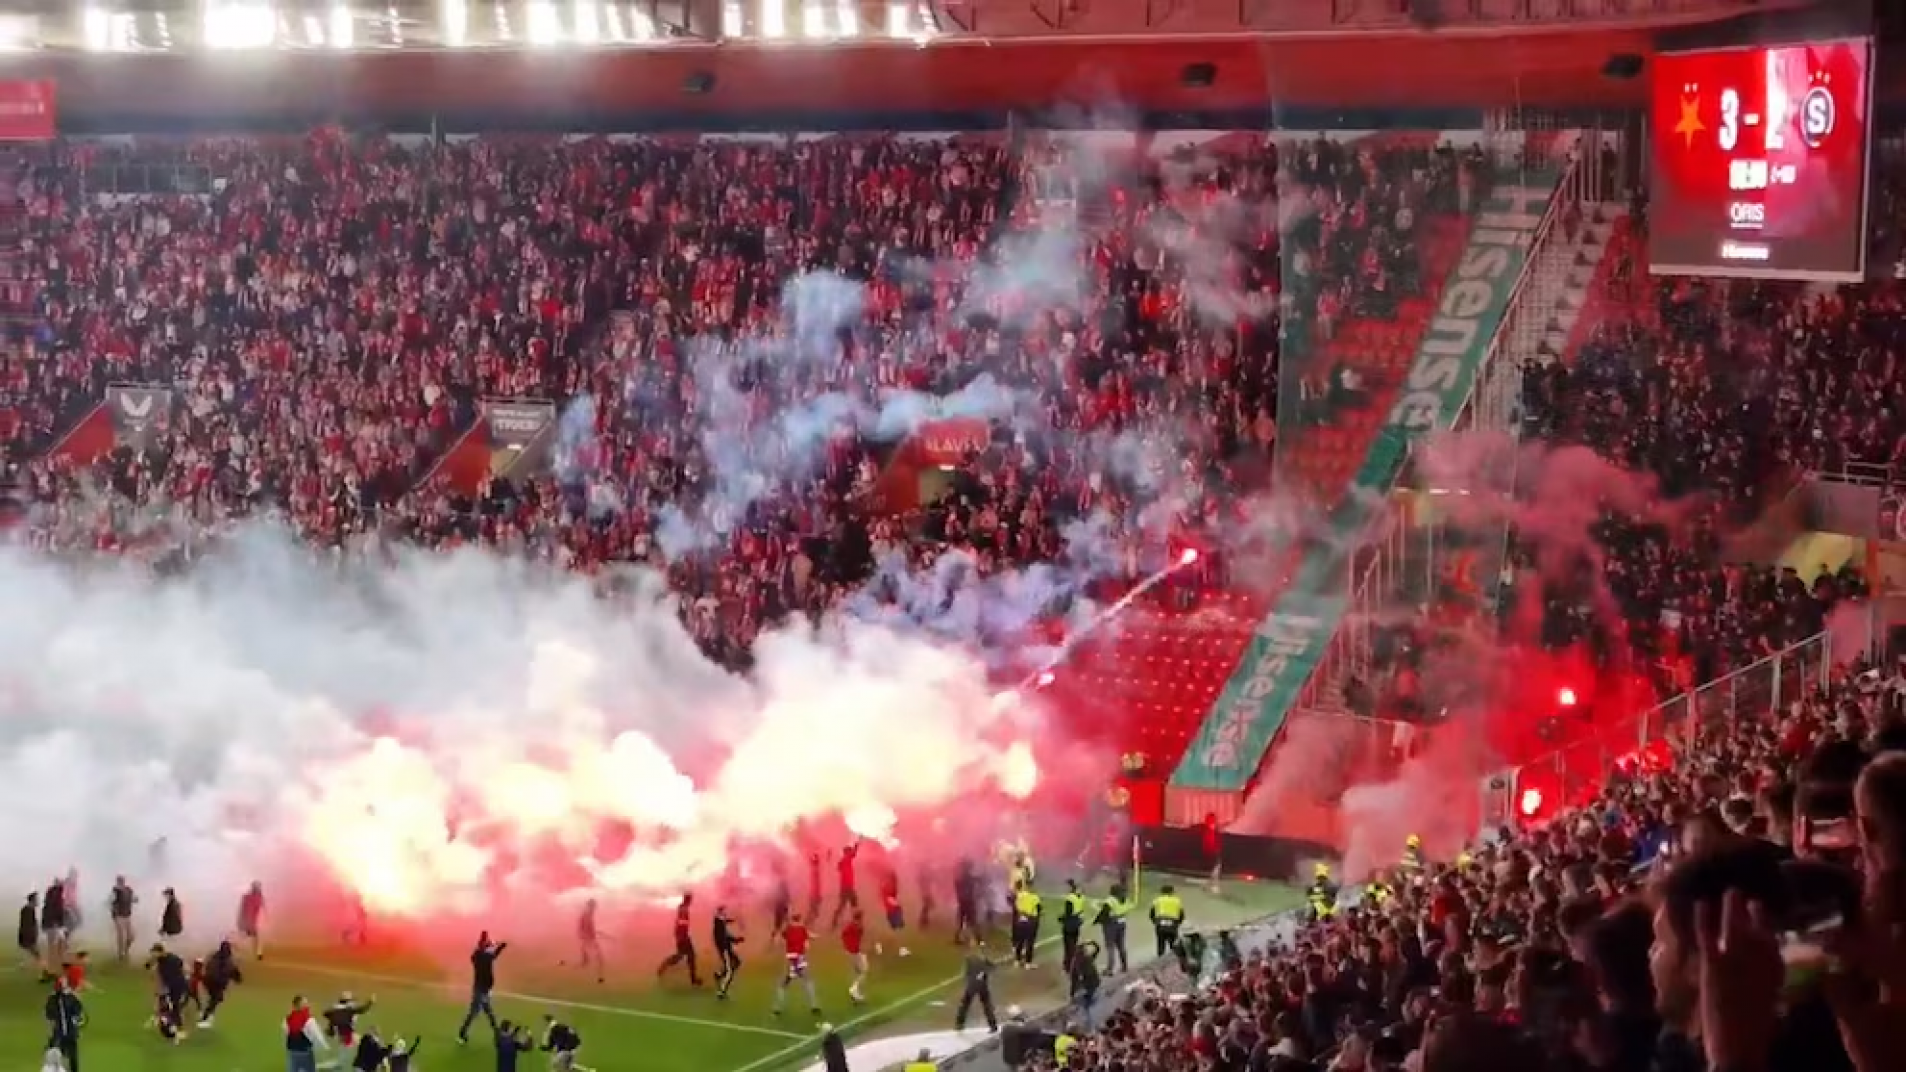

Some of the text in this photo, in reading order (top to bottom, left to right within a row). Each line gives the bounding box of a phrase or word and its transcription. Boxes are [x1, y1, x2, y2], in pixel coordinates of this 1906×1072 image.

[1719, 88, 1739, 150] 3
[1389, 186, 1553, 427] Hisense
[1201, 615, 1323, 768] Hisense
